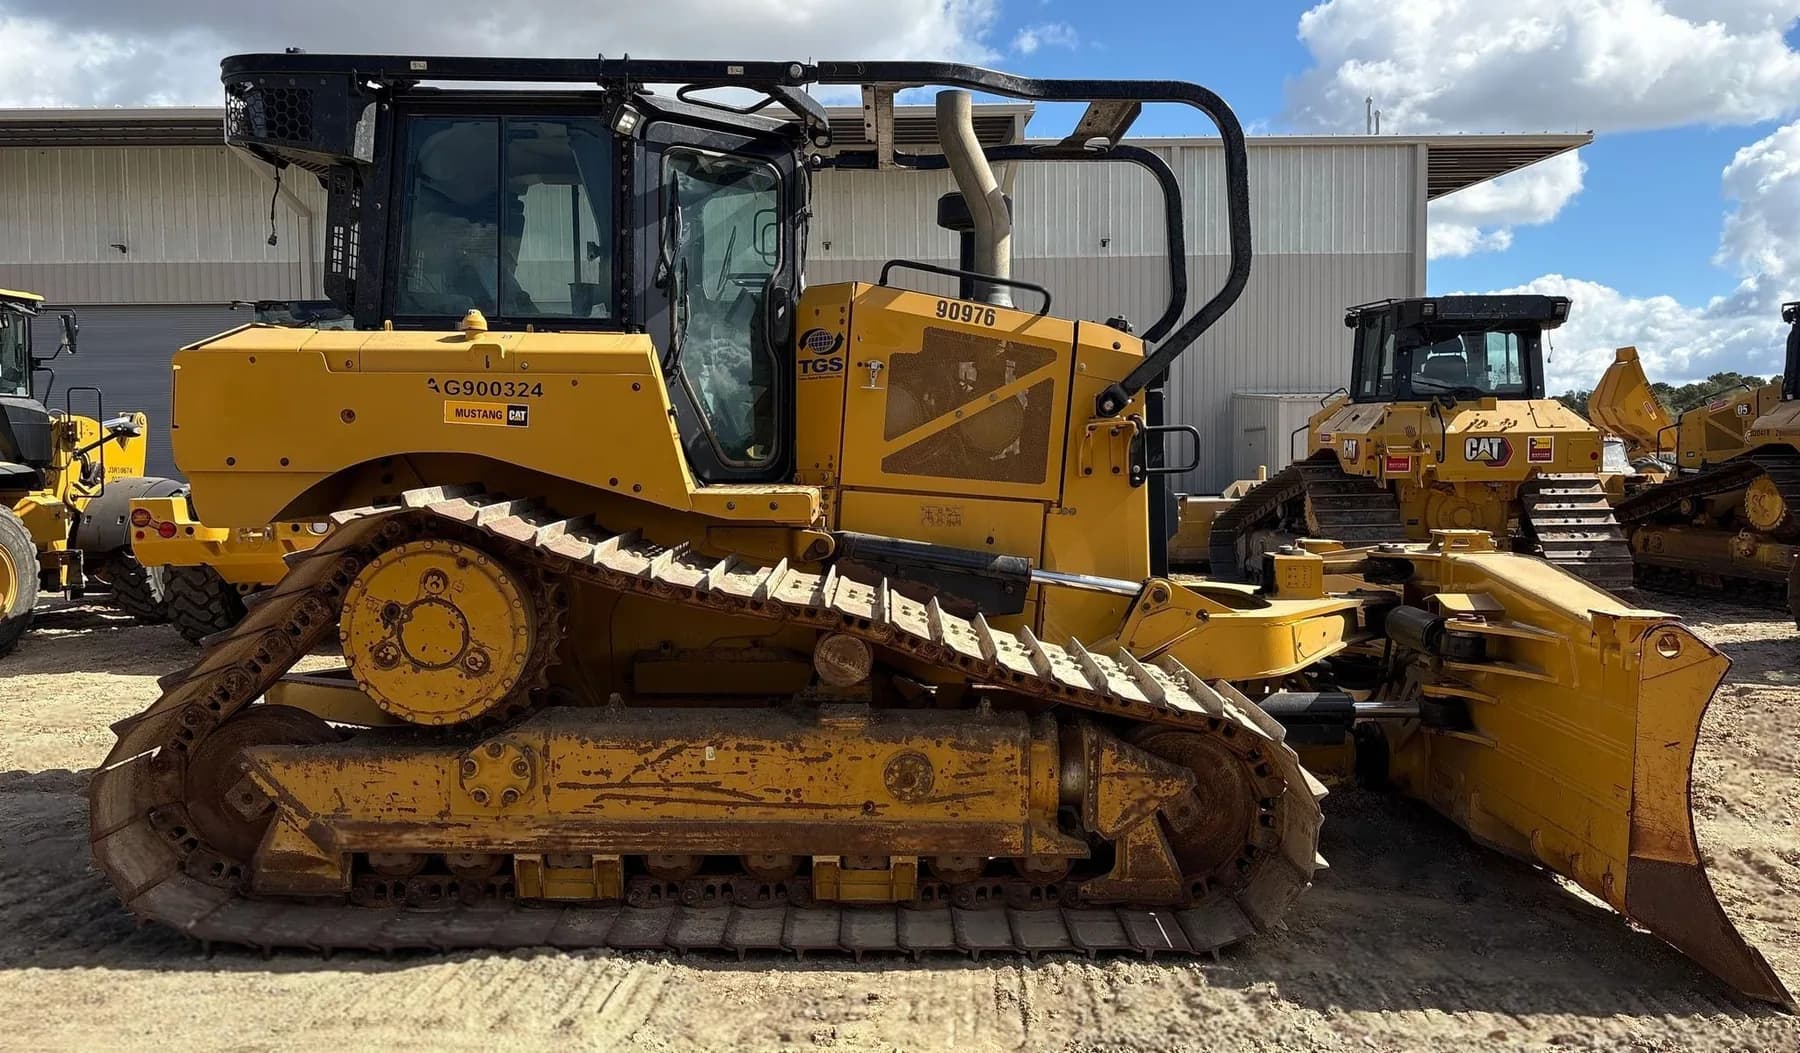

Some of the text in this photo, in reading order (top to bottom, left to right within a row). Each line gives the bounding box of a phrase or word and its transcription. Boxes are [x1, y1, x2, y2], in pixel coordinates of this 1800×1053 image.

[936, 300, 996, 327] 90976
[798, 357, 844, 374] TGS
[455, 408, 526, 421] MUSTANG CAT
[1465, 437, 1502, 461] CAT
